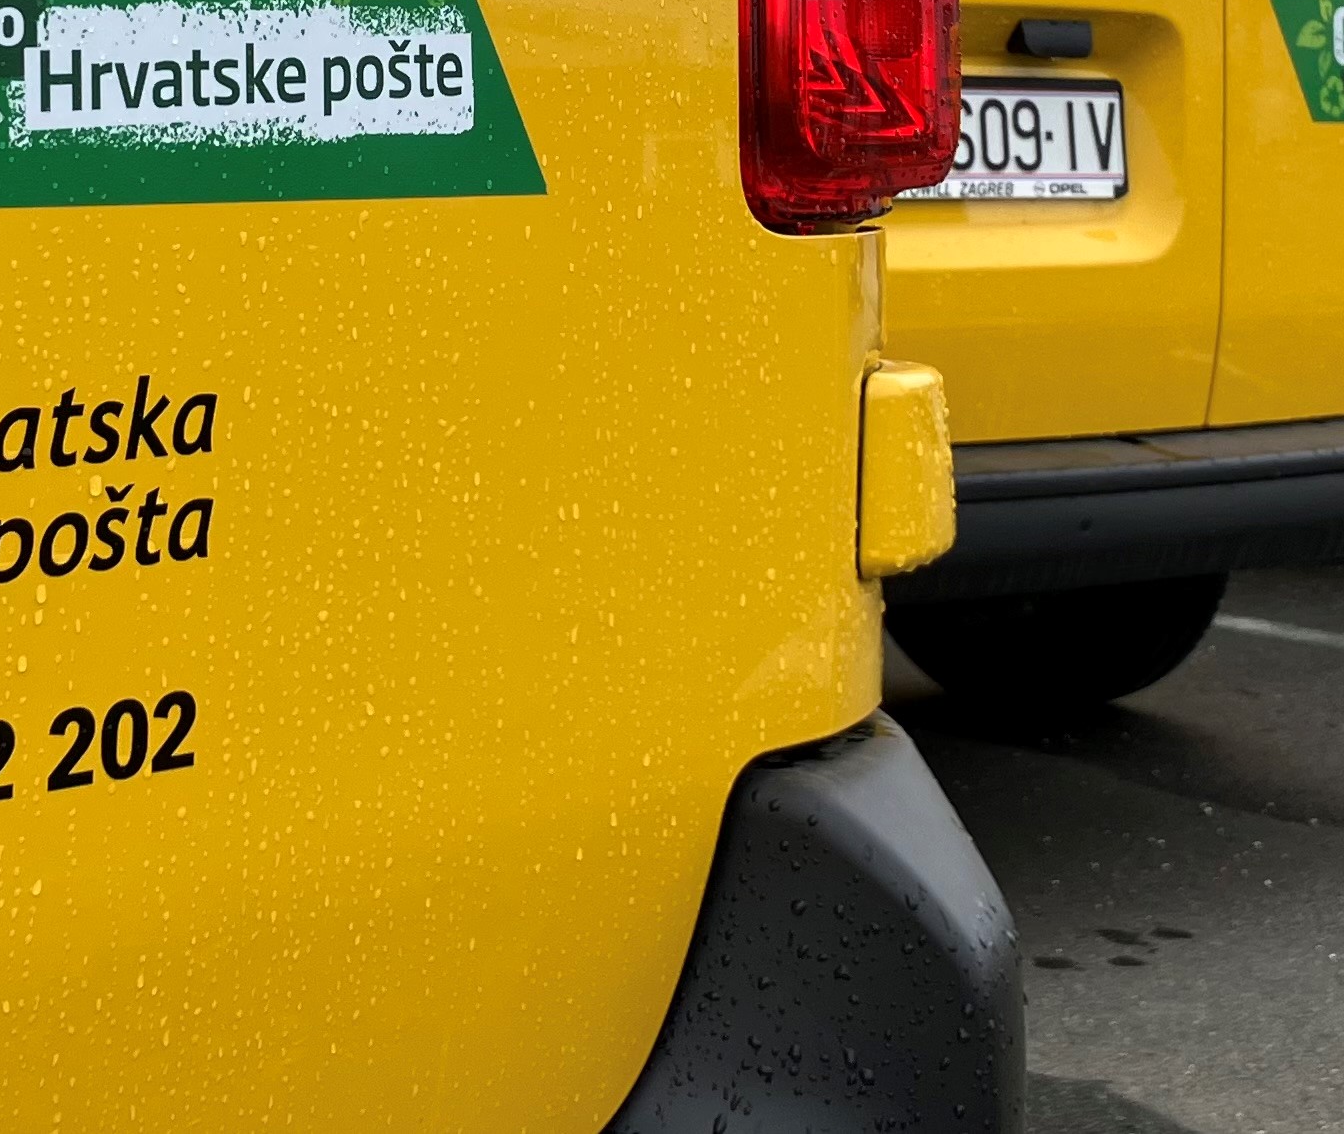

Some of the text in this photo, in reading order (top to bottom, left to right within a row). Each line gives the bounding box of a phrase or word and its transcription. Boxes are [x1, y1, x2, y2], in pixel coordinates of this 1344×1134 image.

[37, 39, 466, 117] Hrvatske pošte
[959, 181, 1015, 198] ZAGREB
[1049, 183, 1087, 195] OPEL
[46, 690, 198, 792] 202
